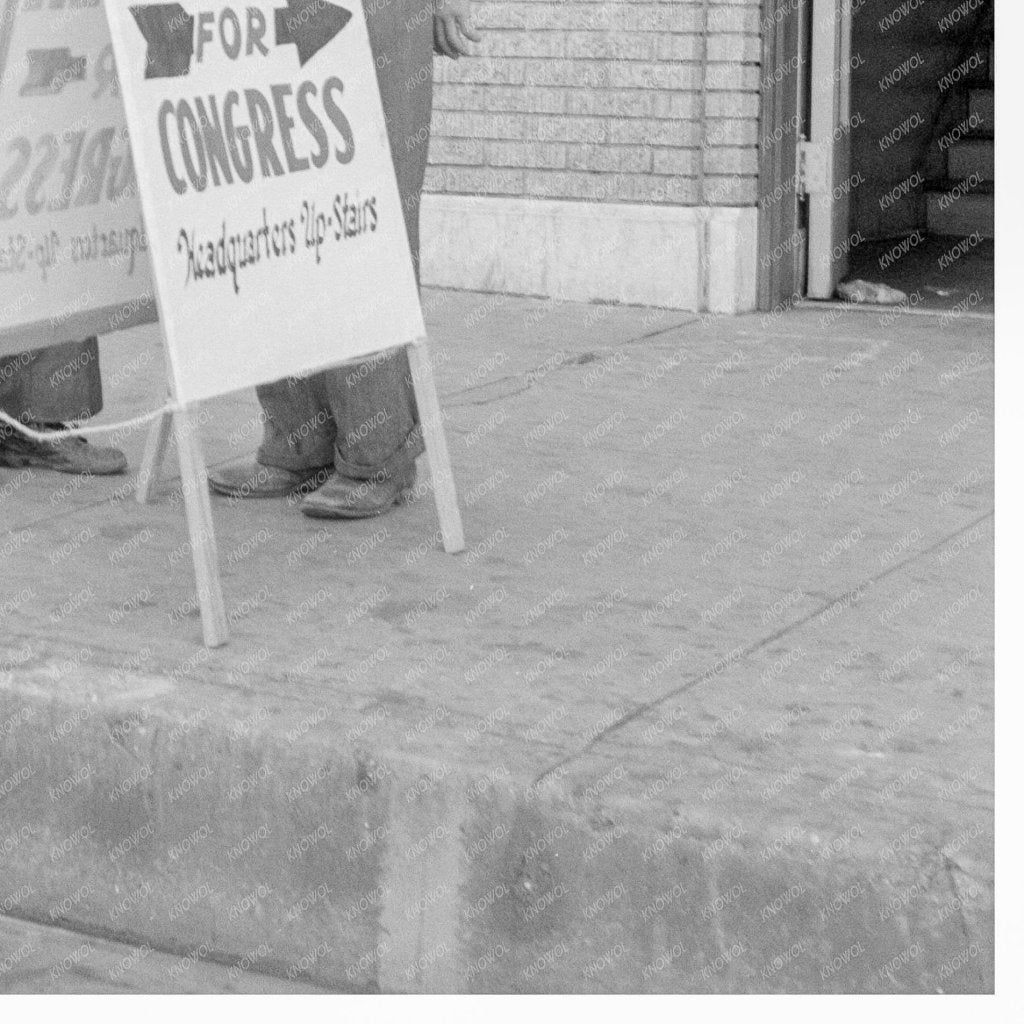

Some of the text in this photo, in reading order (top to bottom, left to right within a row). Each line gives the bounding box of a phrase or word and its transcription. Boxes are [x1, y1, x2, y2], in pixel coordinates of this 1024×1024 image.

[194, 7, 270, 64] FOR
[157, 76, 356, 195] CONGRESS
[177, 207, 297, 295] Headquarters
